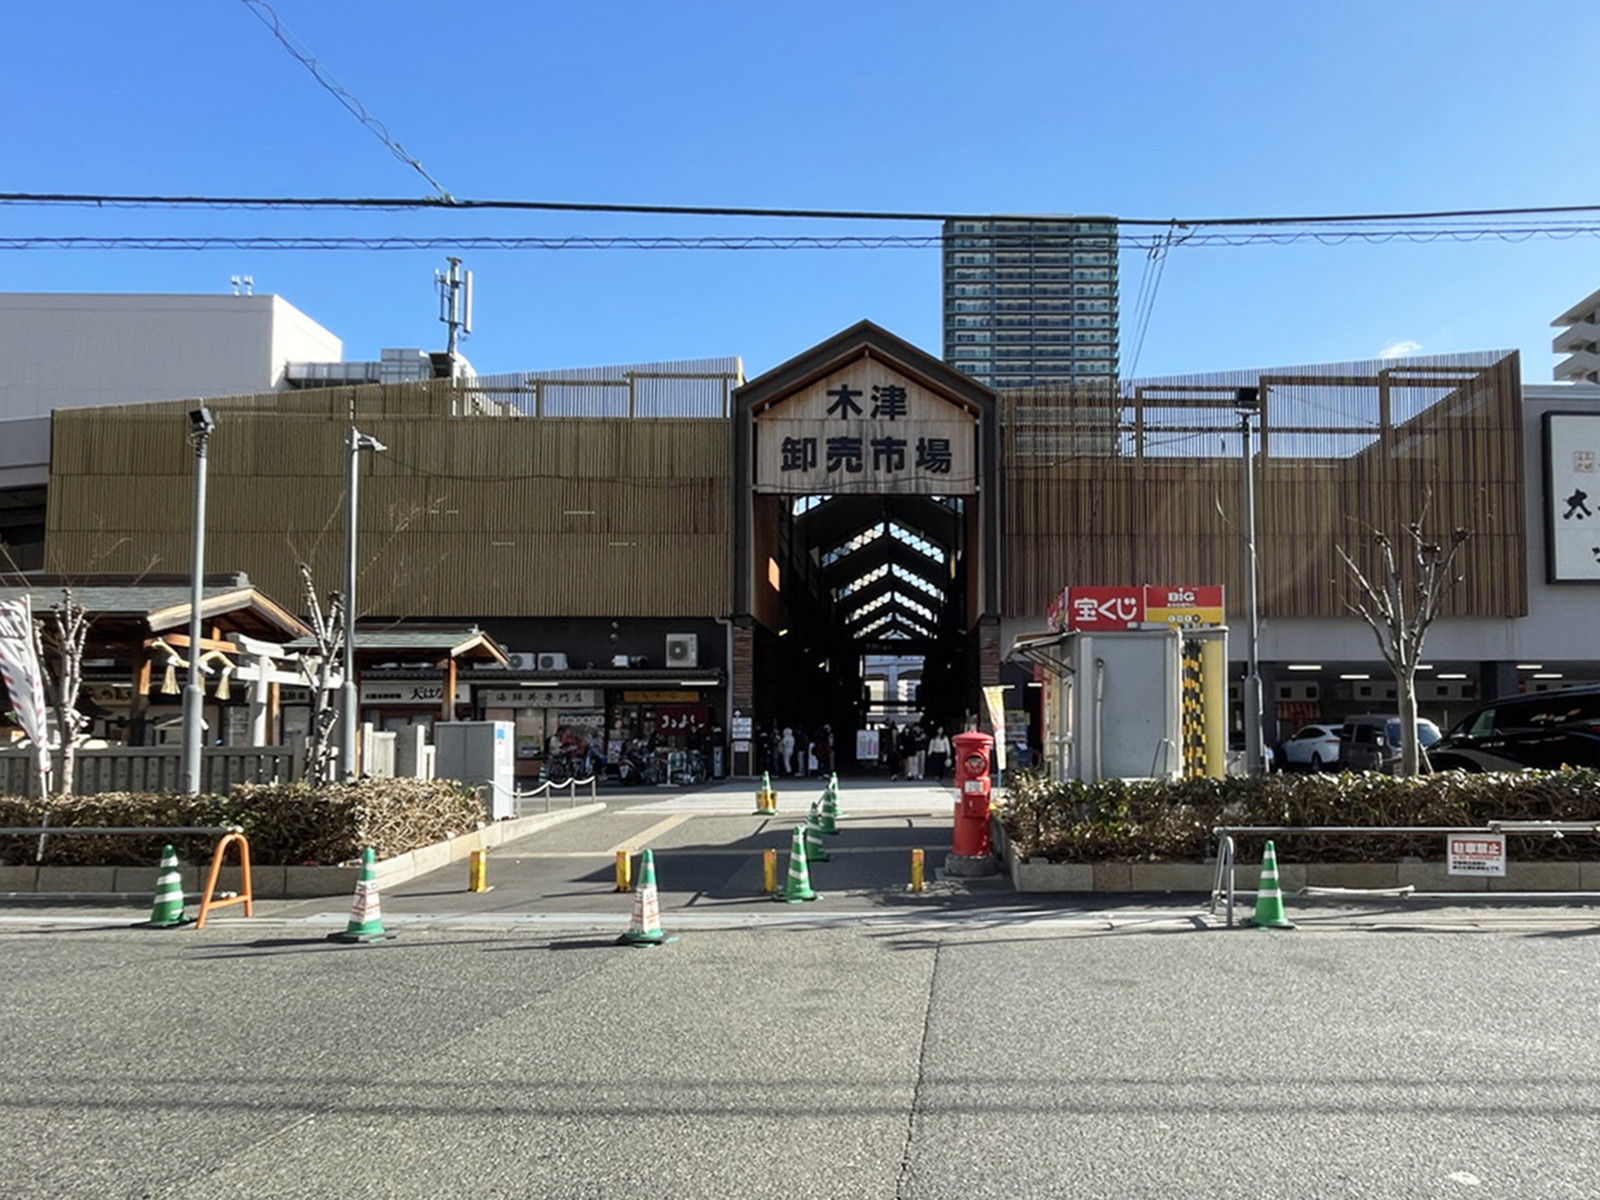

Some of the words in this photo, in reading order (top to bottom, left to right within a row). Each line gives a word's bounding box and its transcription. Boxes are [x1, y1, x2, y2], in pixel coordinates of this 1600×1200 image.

[826, 384, 907, 421] 木津
[781, 436, 952, 473] 卸売市場
[1563, 488, 1600, 520] 太
[1074, 597, 1137, 621] 宝くじ
